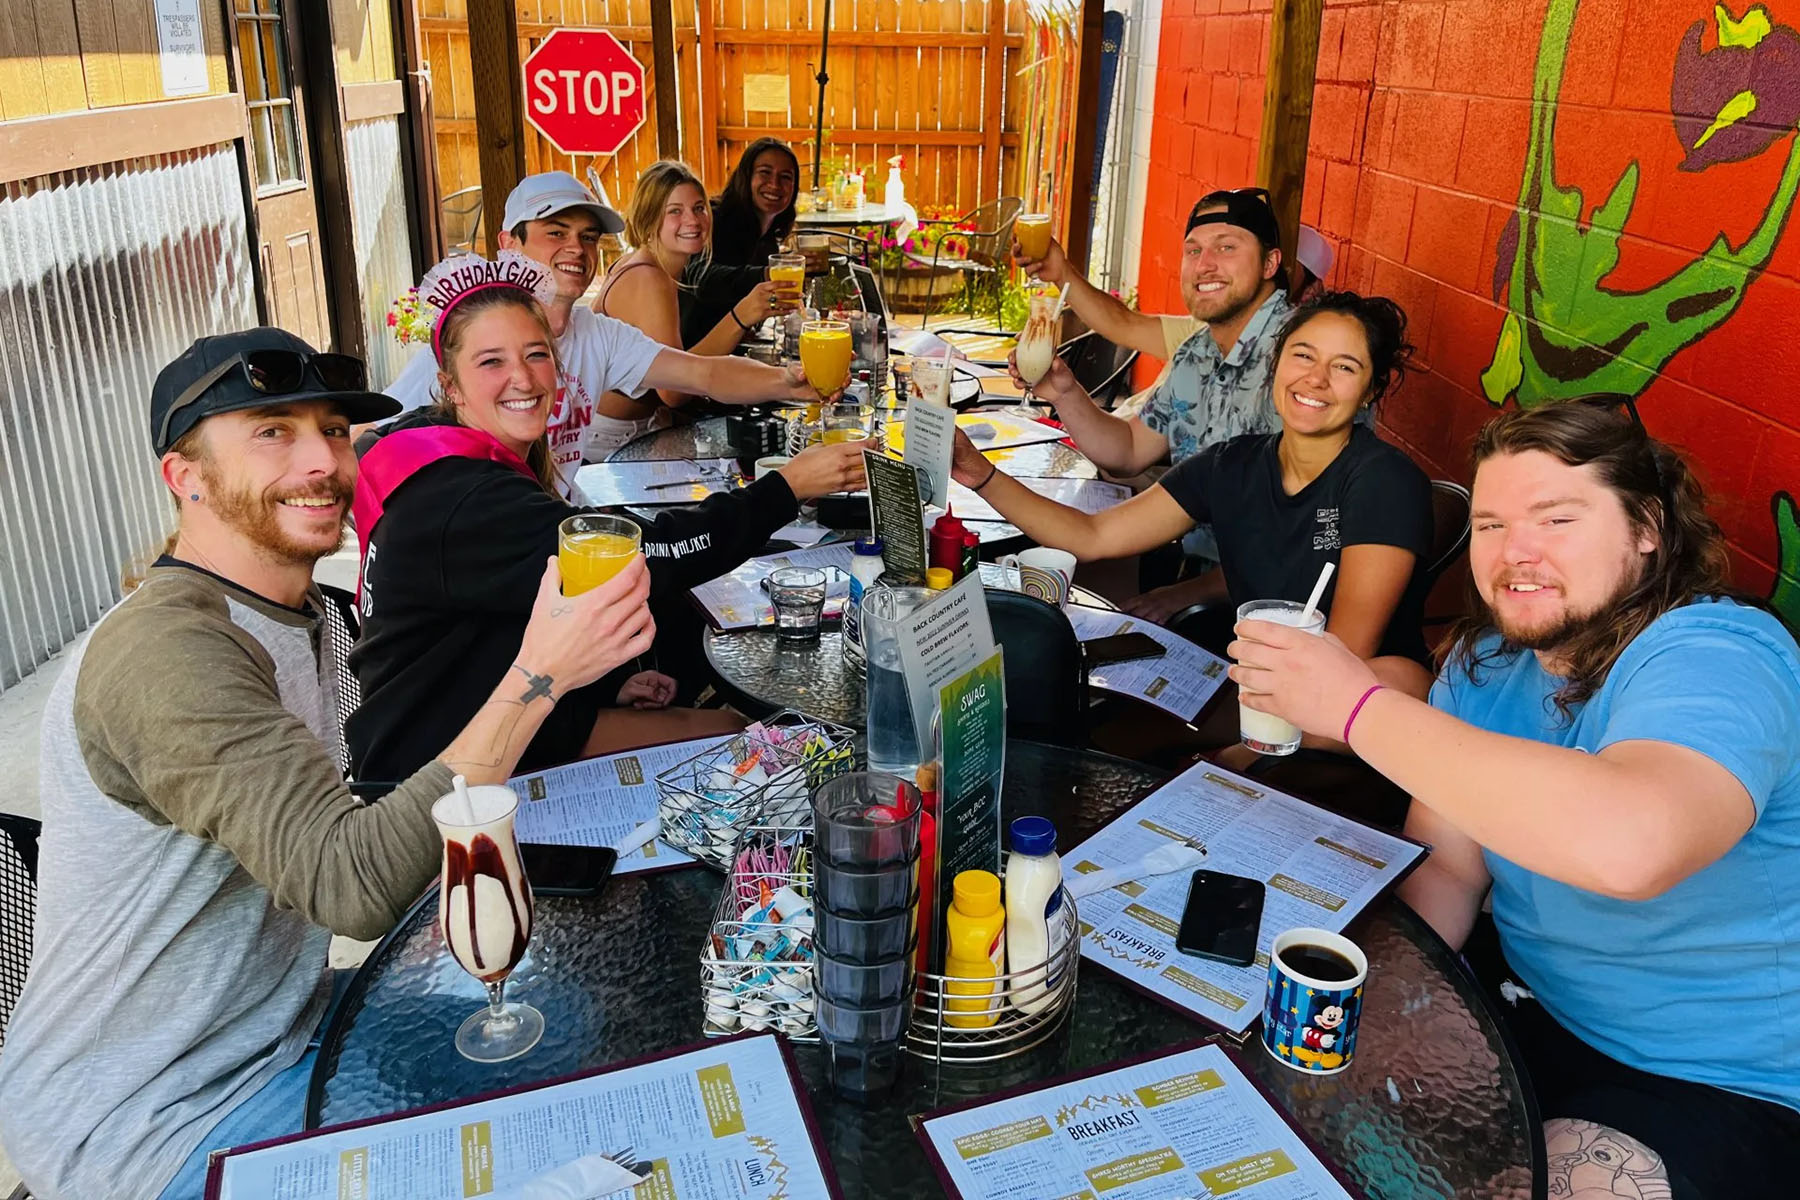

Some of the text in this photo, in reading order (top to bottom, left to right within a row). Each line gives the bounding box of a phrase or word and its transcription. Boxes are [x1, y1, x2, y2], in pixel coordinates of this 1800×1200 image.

[533, 68, 636, 116] STOP
[427, 261, 544, 310] BIRTHDAY GIRL
[670, 532, 711, 559] WHISKEY
[913, 620, 928, 633] BACK
[928, 603, 954, 624] COUNTRY
[920, 645, 934, 657] COLD
[934, 636, 949, 649] BREW
[960, 684, 986, 712] SWAG
[1104, 927, 1166, 961] BREAKFAST
[1068, 1109, 1141, 1141] BREAKFAST
[744, 1158, 766, 1188] LUNCH
